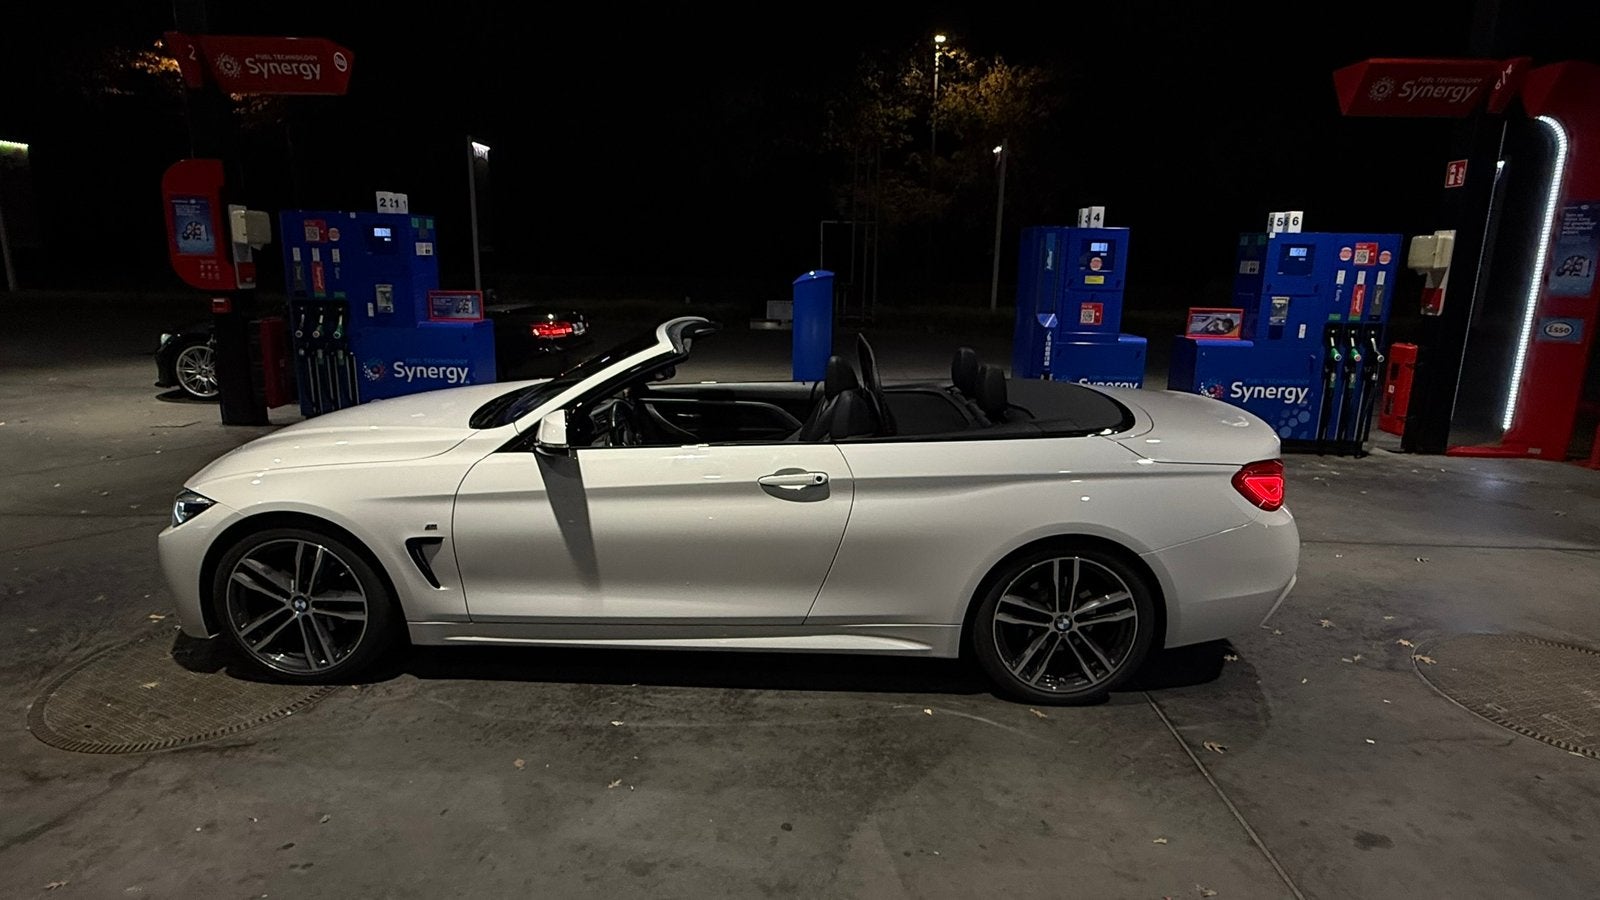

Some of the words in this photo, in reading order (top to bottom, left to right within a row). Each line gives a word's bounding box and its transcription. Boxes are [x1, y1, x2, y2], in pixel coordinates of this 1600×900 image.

[187, 44, 197, 61] 2
[245, 57, 321, 80] Synergy
[1398, 80, 1479, 103] Synergy
[379, 197, 387, 207] 2
[394, 199, 399, 208] 1
[1093, 213, 1100, 222] 4
[1276, 217, 1284, 226] 5
[1292, 216, 1299, 226] 6
[1548, 325, 1570, 333] Esso
[393, 361, 469, 384] Synergy
[1230, 381, 1309, 404] Synergy
